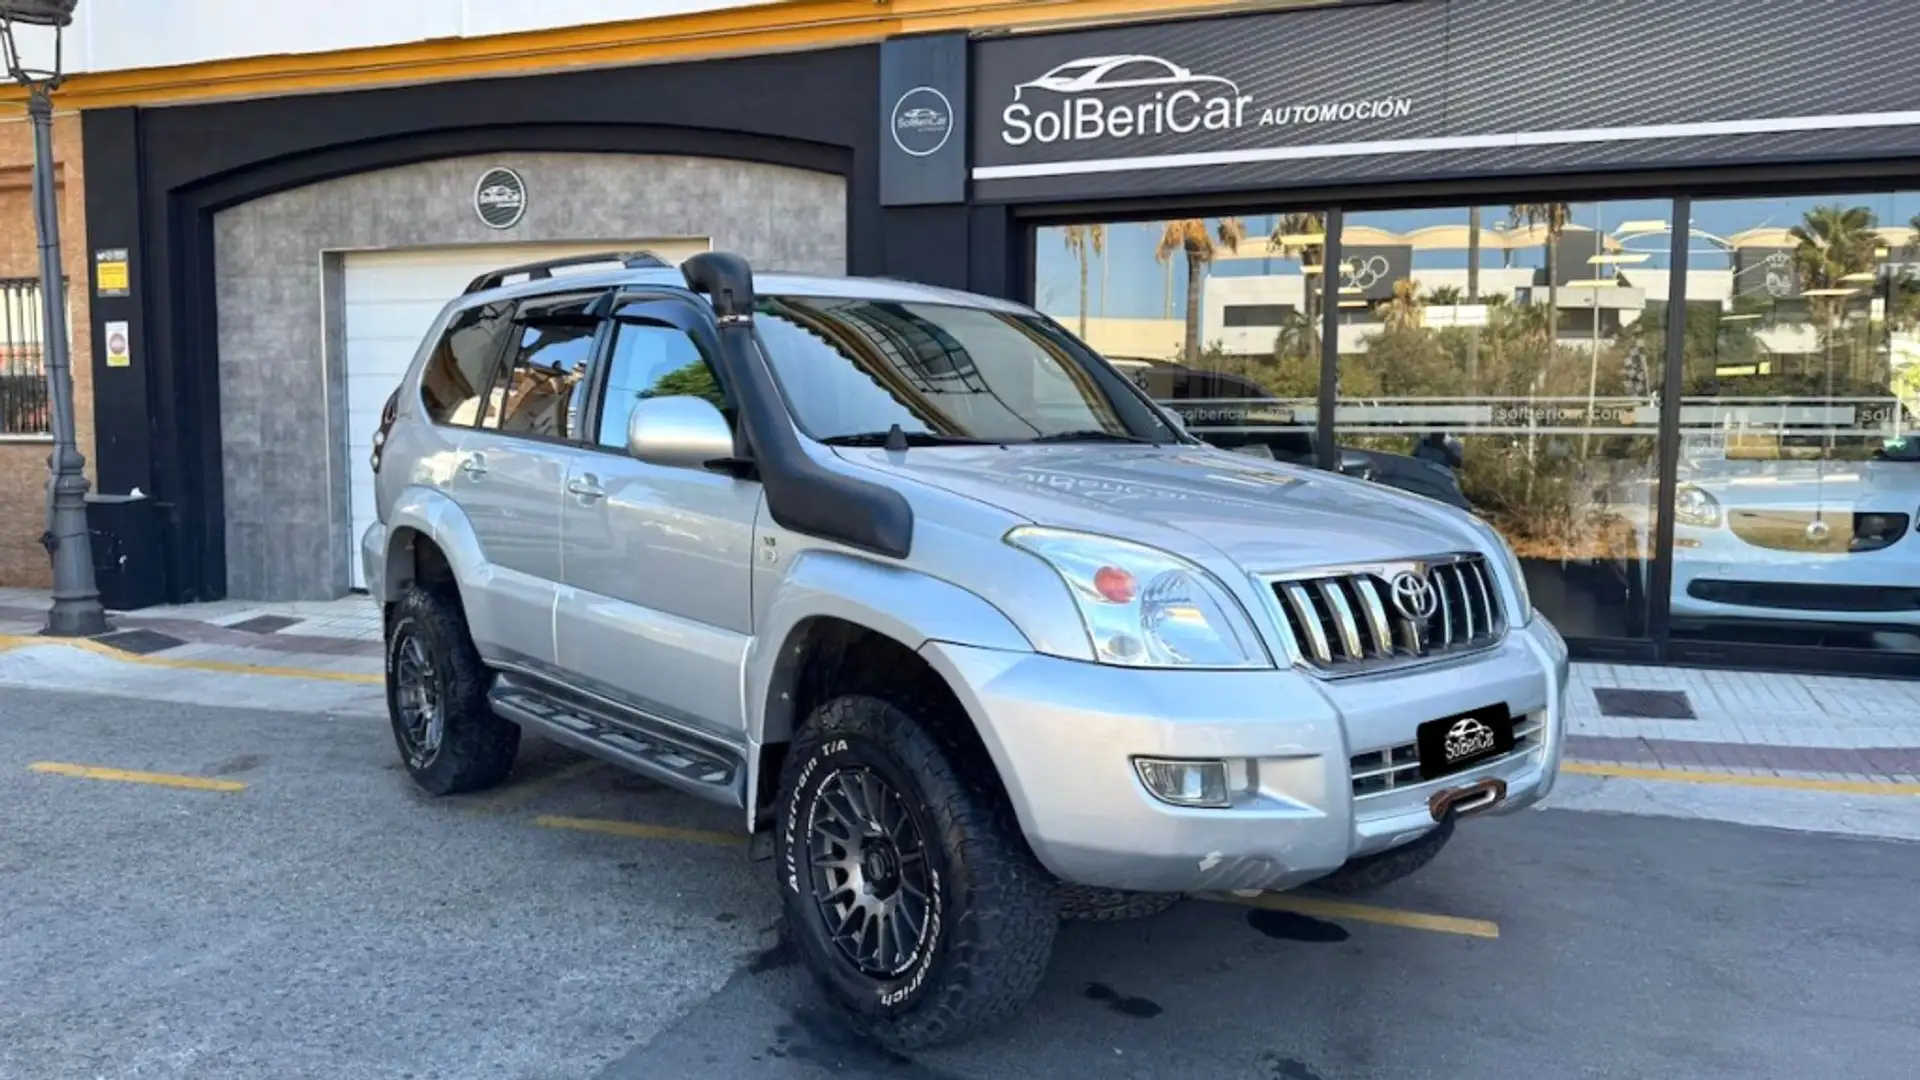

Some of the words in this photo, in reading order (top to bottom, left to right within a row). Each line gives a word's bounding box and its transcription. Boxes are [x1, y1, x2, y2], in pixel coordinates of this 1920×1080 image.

[1001, 90, 1253, 146] SolBeriCar
[1258, 96, 1412, 127] AUTOMOCIÓN
[786, 757, 818, 894] All-Terrain
[822, 739, 849, 757] T/A
